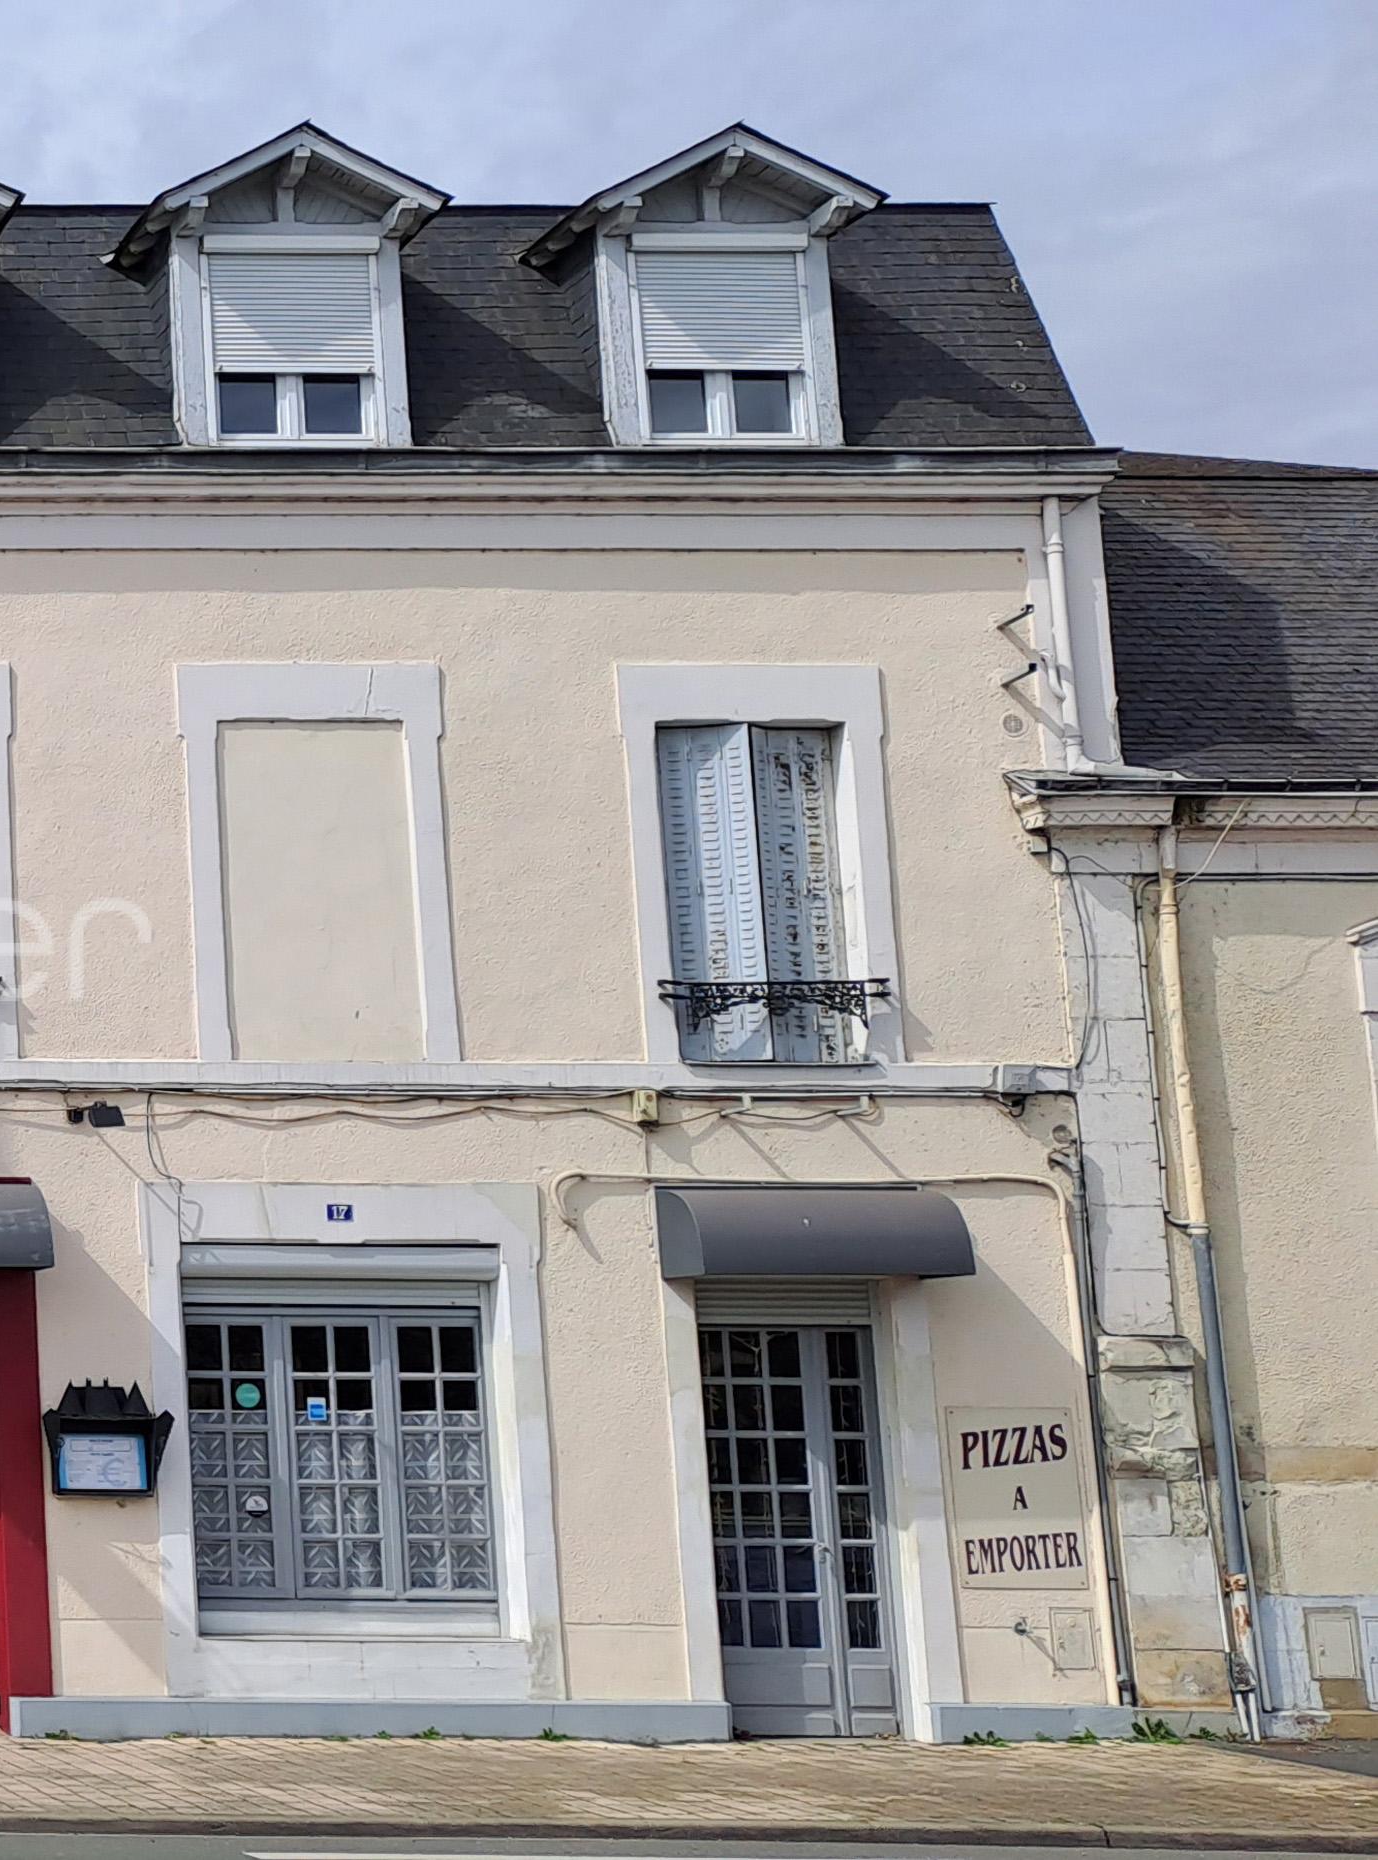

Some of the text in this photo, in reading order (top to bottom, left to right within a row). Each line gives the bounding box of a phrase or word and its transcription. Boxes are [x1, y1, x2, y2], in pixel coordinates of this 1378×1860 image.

[331, 1205, 348, 1220] 17
[960, 1424, 1068, 1470] PIZZAS
[1012, 1485, 1029, 1511] A
[964, 1532, 1083, 1575] EMPORTER
